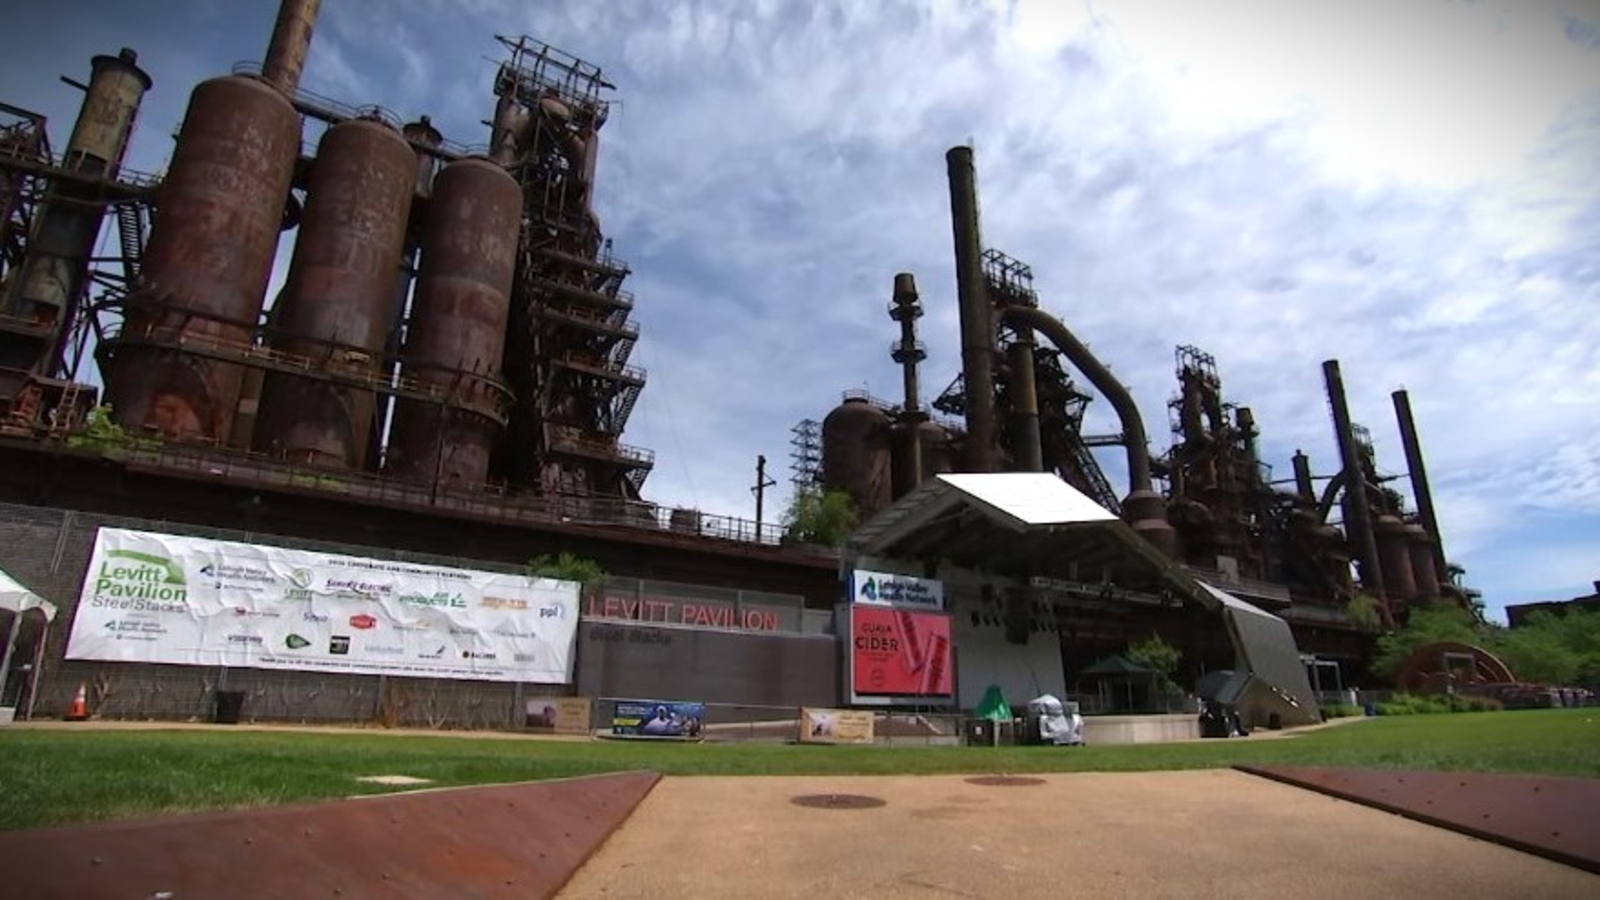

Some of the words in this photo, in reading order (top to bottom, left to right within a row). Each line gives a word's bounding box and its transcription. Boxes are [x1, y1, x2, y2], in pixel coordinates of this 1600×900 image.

[101, 561, 161, 581] Levitt
[96, 578, 187, 602] Pavilion
[589, 595, 674, 624] LEVITT
[681, 604, 779, 632] PAVILION
[855, 636, 899, 651] CIDER
